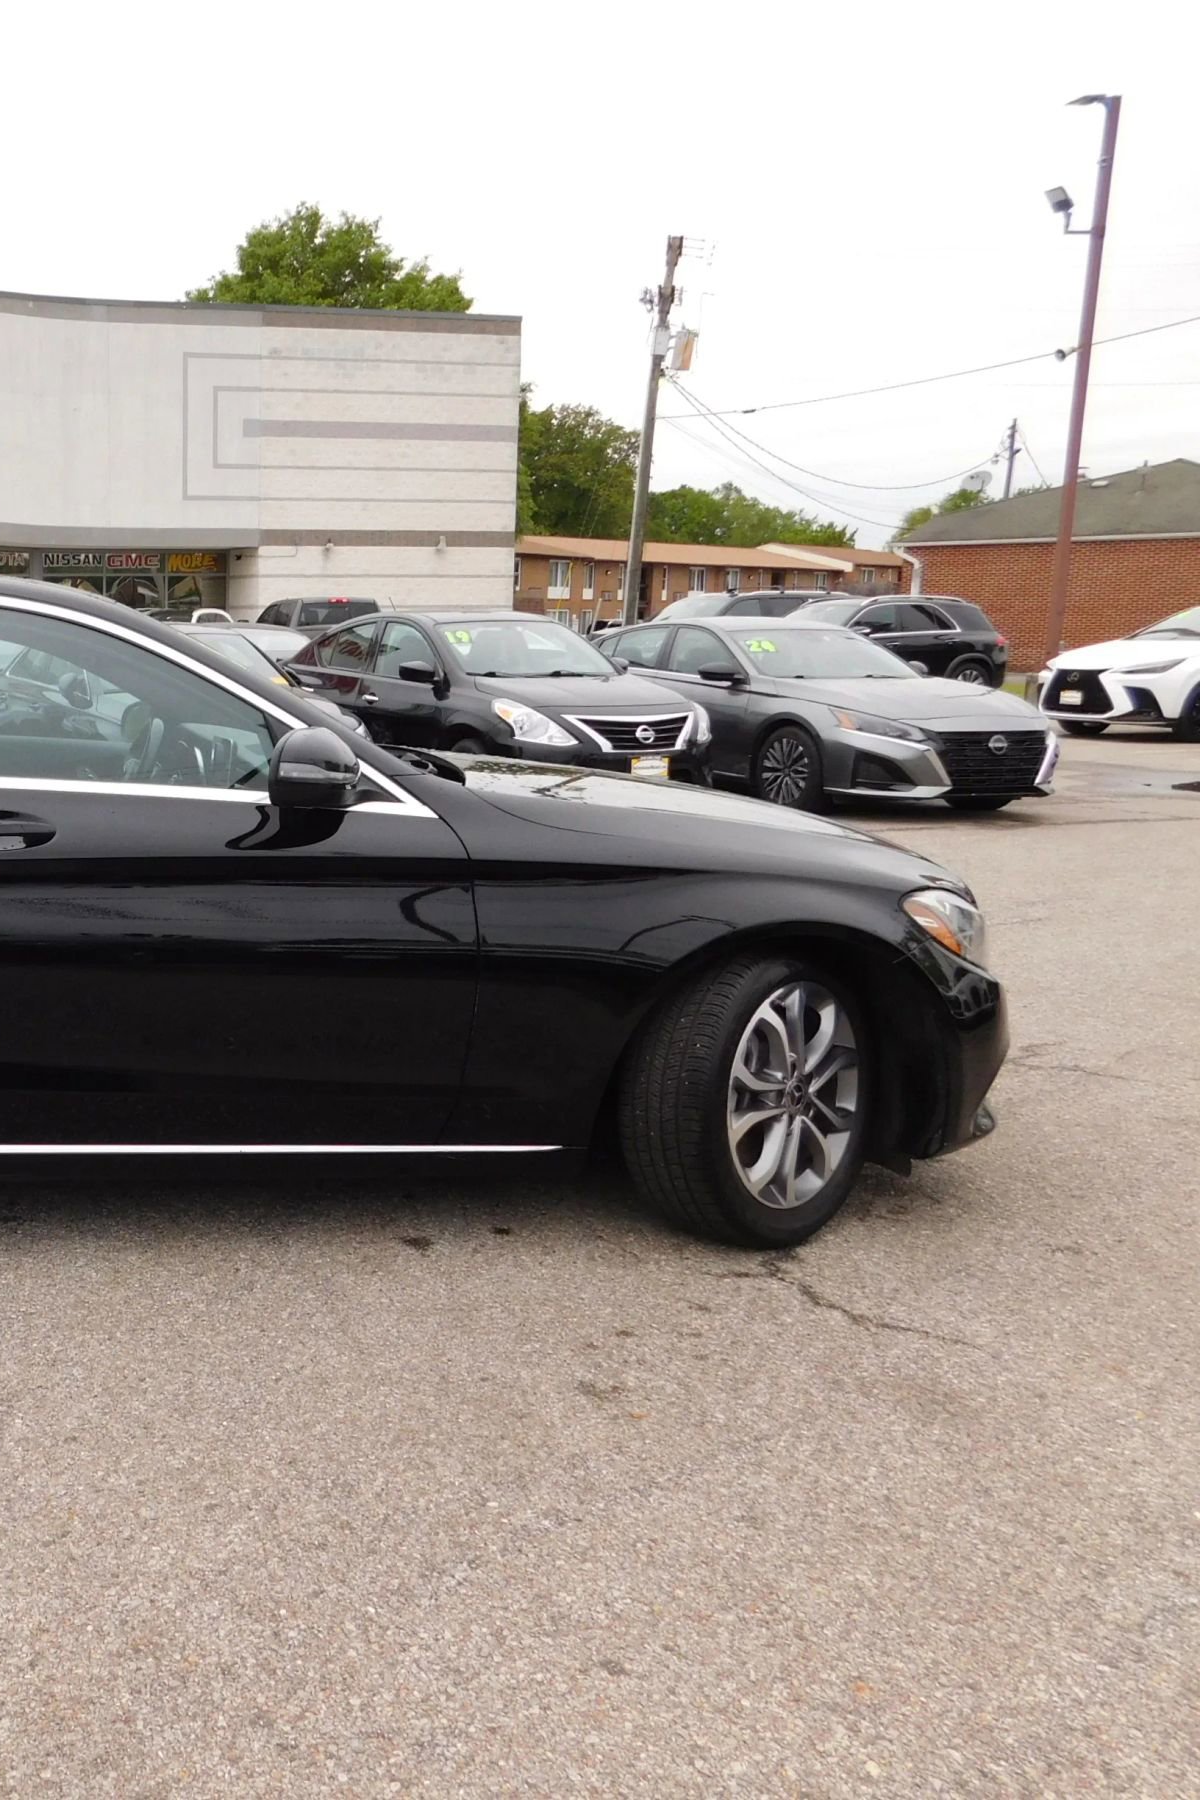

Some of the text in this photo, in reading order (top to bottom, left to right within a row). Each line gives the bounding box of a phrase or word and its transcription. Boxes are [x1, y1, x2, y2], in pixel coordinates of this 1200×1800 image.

[43, 553, 101, 568] NISSAN
[106, 553, 160, 568] GMC
[168, 553, 217, 572] MORE
[445, 630, 469, 643] 19
